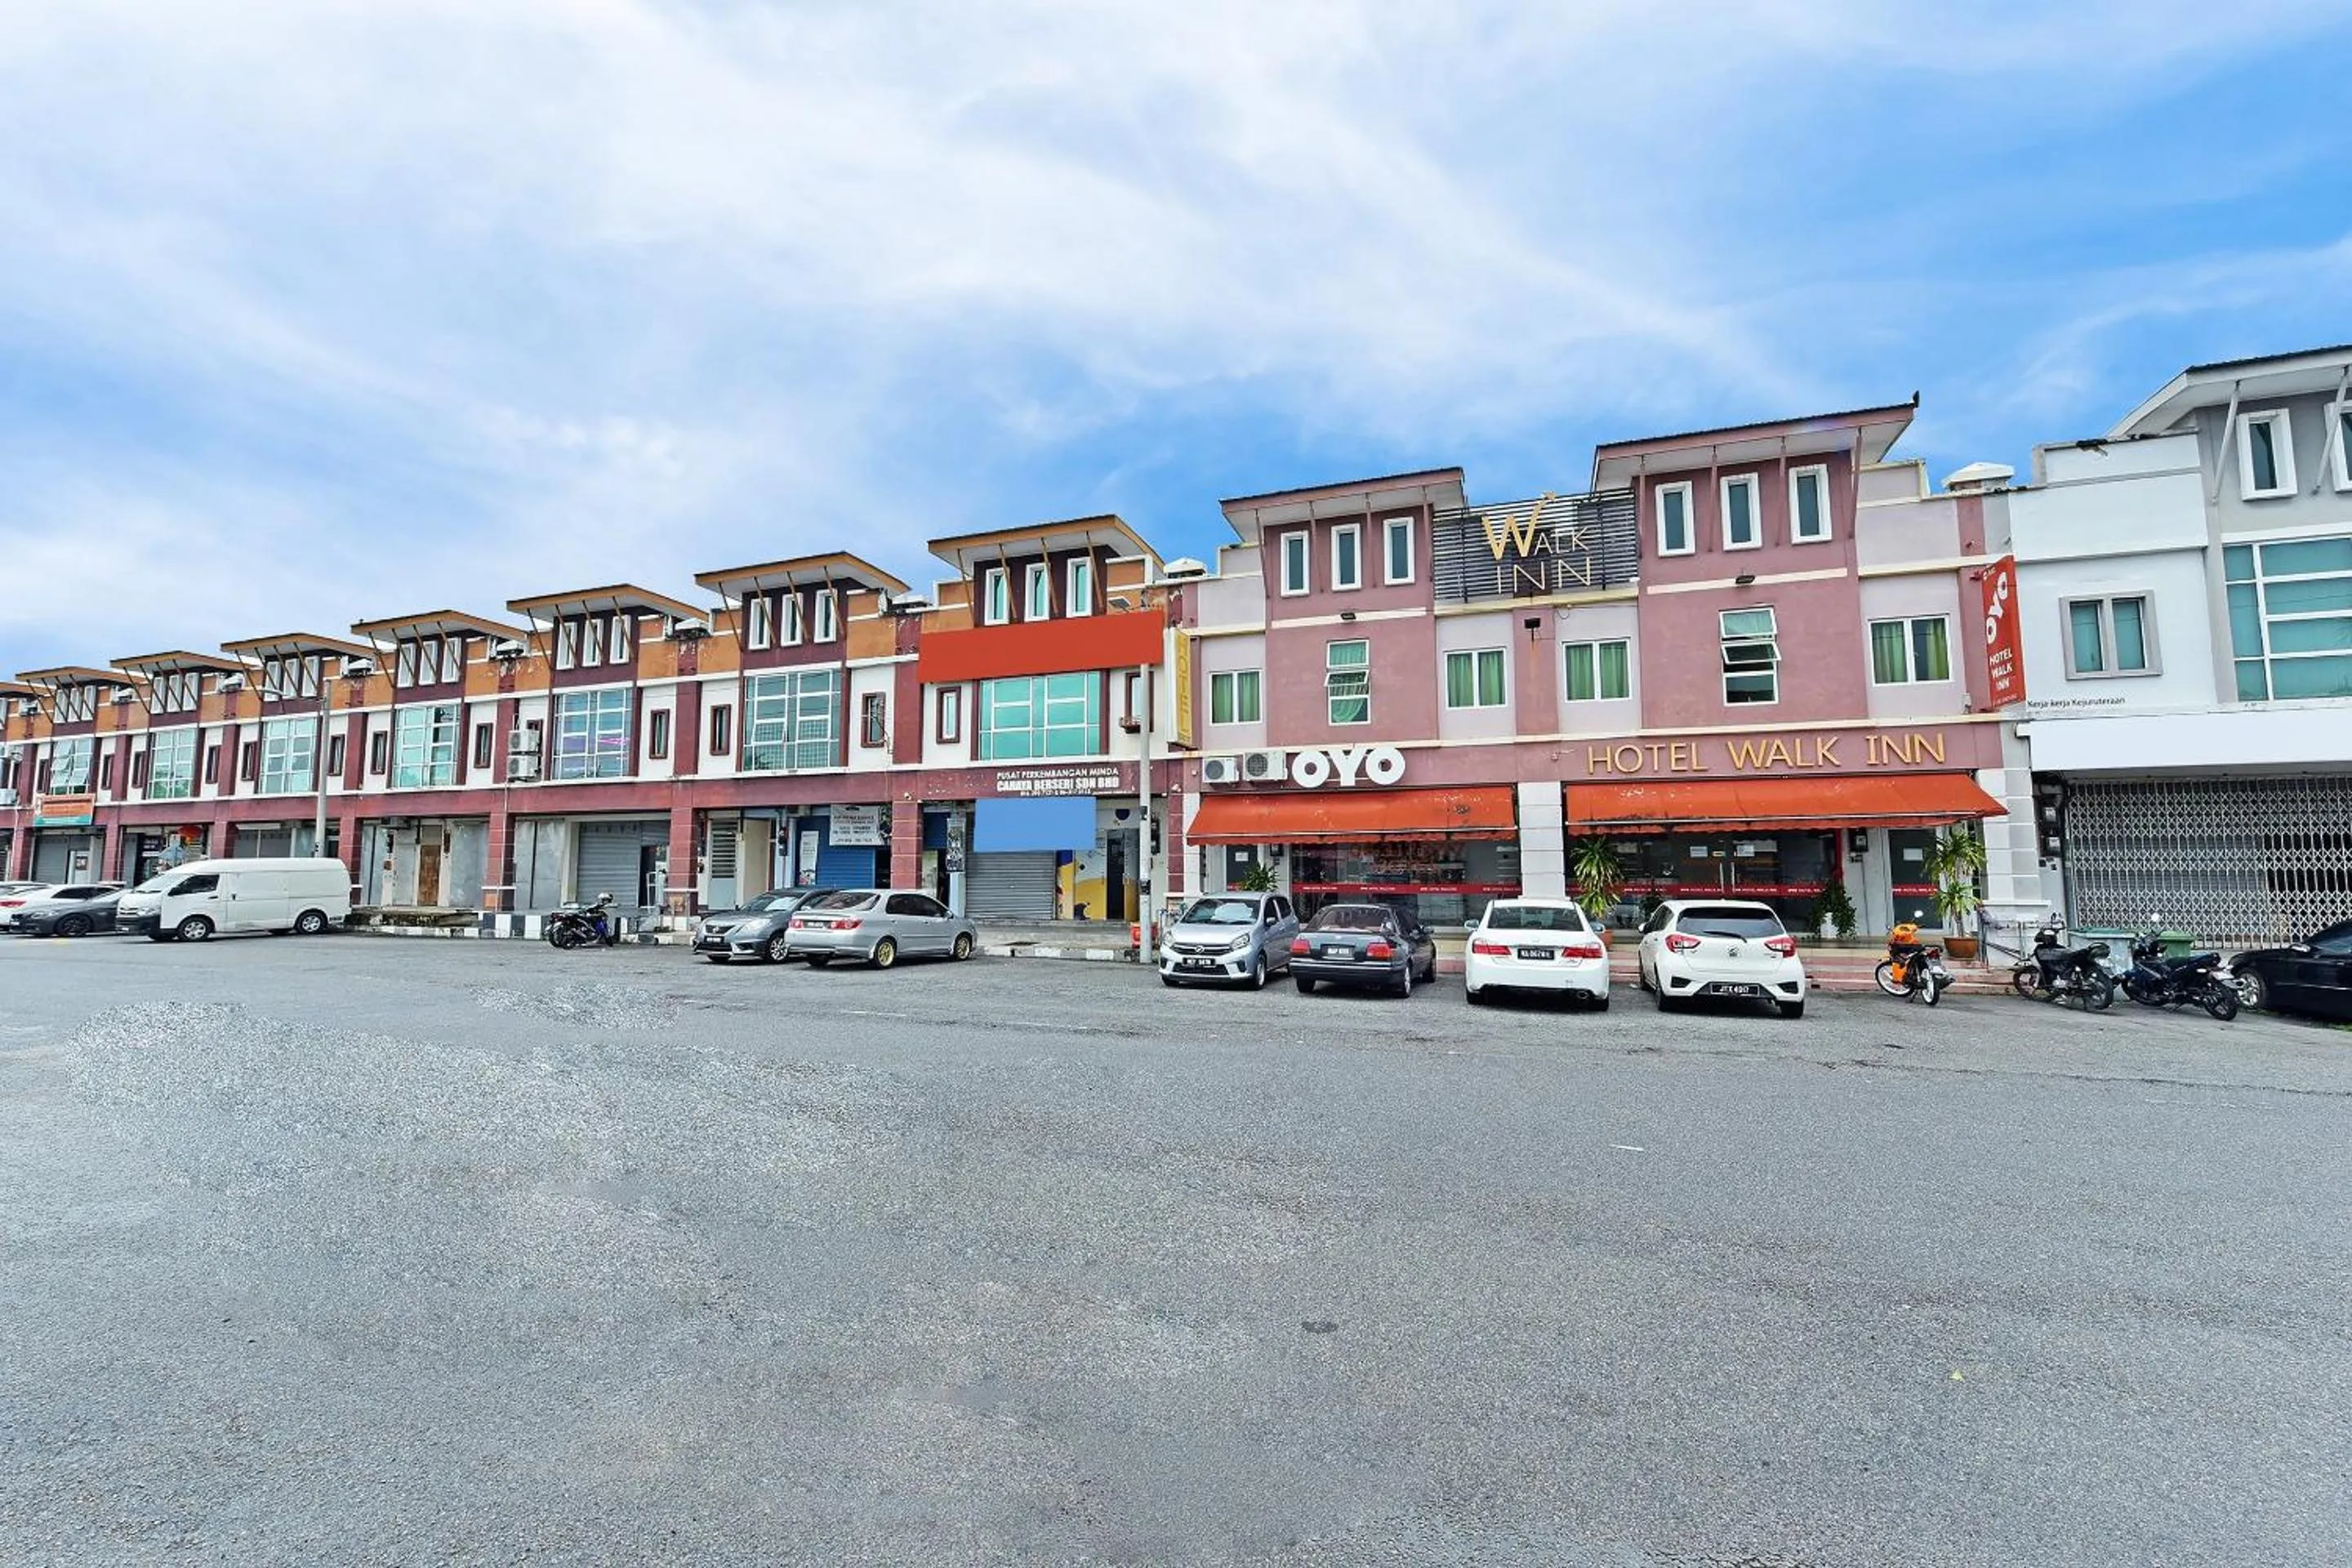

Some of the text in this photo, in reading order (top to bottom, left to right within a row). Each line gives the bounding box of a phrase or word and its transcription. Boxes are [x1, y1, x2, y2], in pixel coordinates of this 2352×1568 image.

[1497, 557, 1590, 595] INN
[1985, 572, 2008, 645] OYO
[1989, 647, 2012, 666] HOTEL
[1991, 663, 2012, 679] WALK
[1178, 633, 1189, 732] HOTEL
[1291, 746, 1405, 788] OYO
[1587, 733, 1944, 774] HOTEL WALK INN
[997, 767, 1119, 780] PUSAT PERKEMBANGAN MINDA
[1034, 777, 1073, 791] BERSERI
[1076, 777, 1096, 789] SDN
[1098, 776, 1119, 788] BHD
